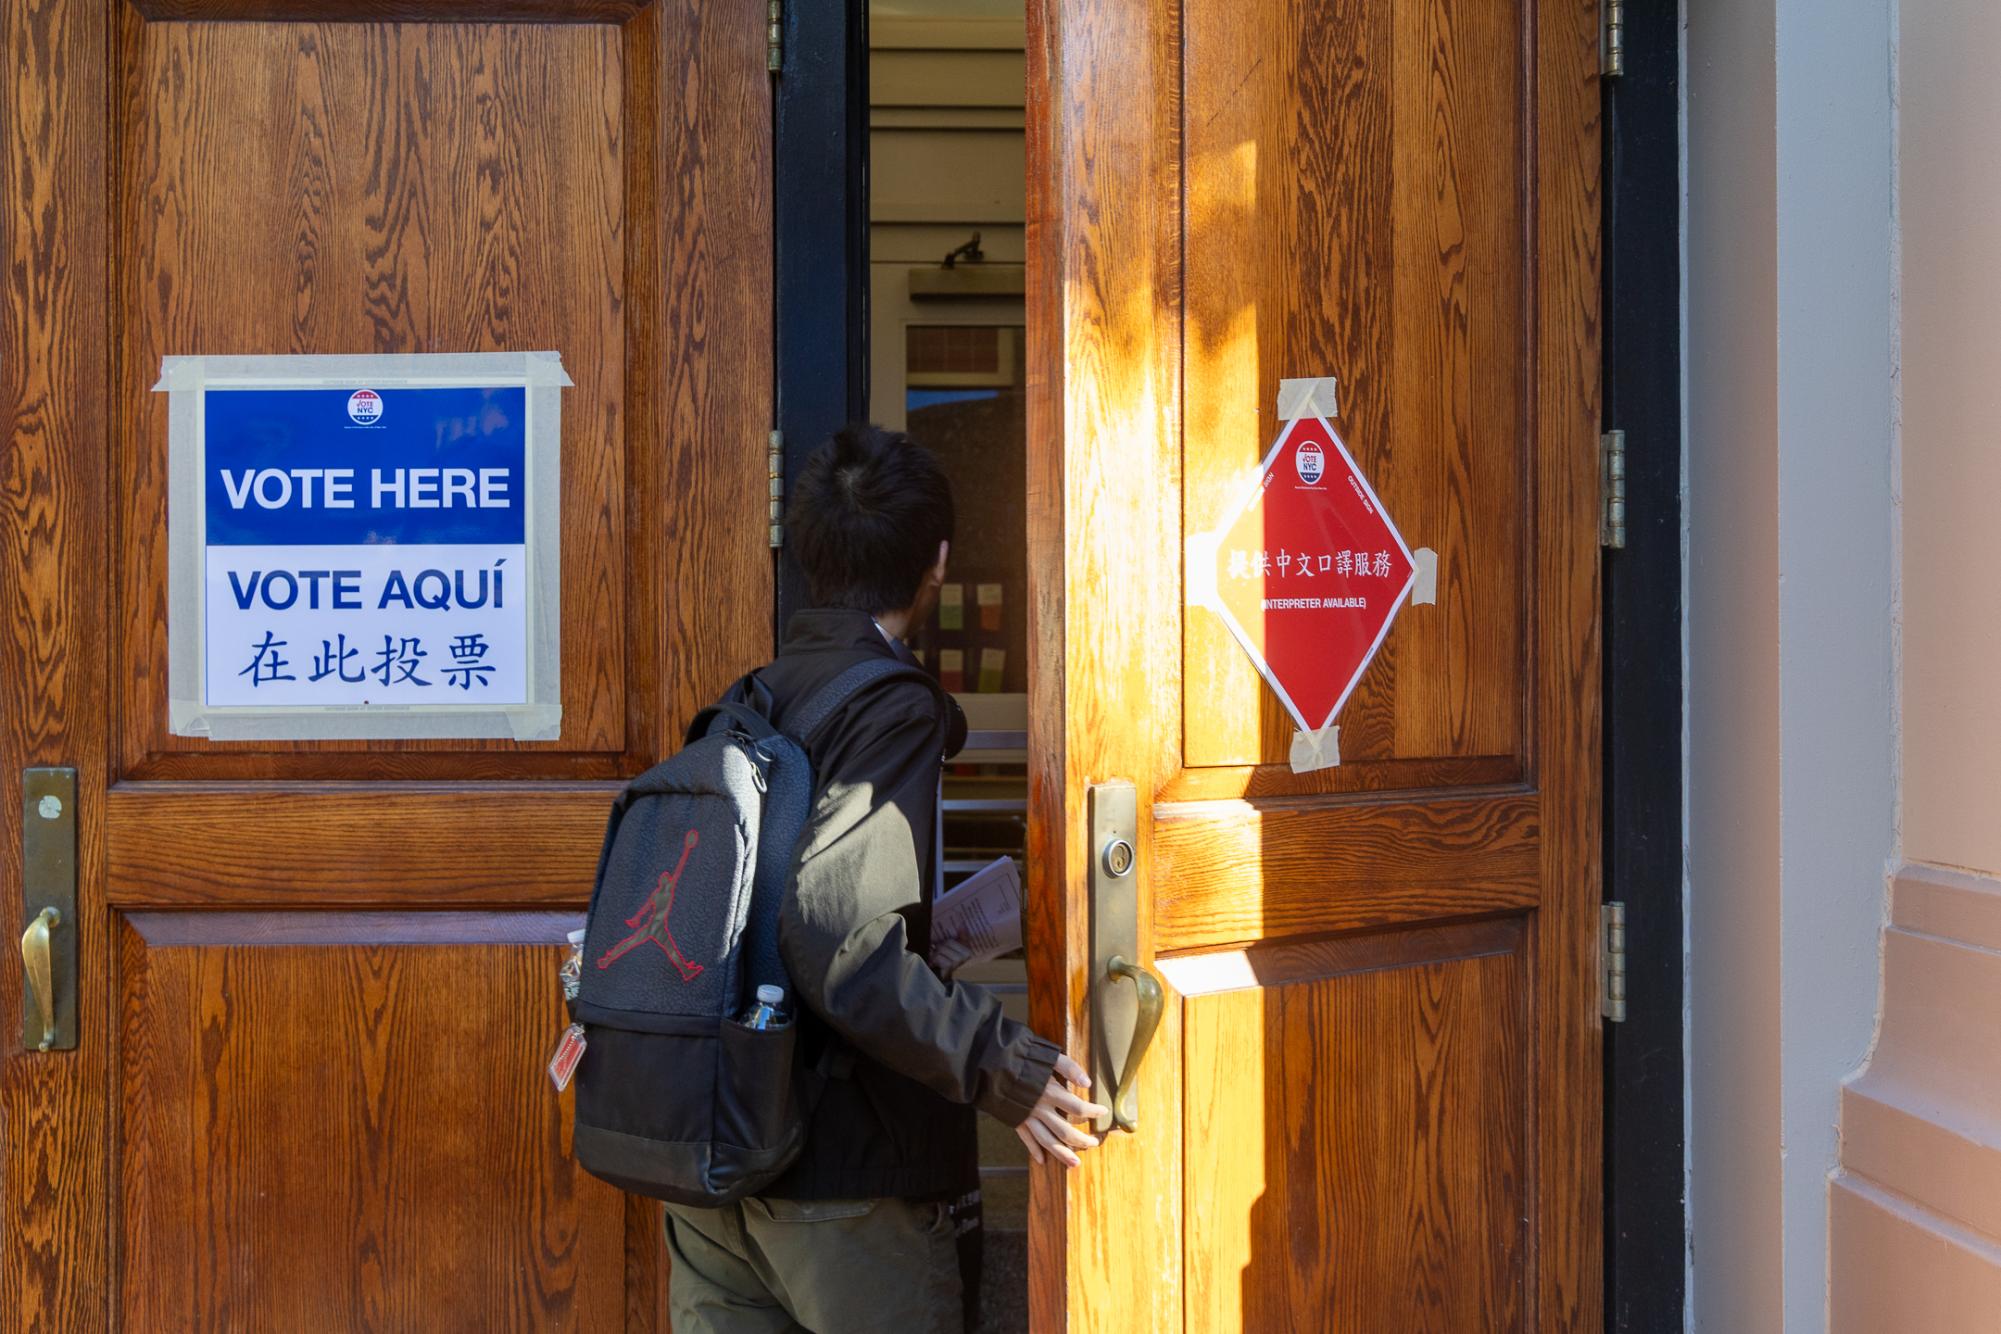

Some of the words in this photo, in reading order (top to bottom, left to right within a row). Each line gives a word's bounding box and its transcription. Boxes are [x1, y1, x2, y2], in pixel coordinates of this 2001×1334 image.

[1302, 463, 1318, 471] NYC
[220, 467, 355, 510] VOTE
[370, 467, 511, 509] HERE
[1228, 548, 1393, 579] 提供中文口譯服務
[227, 569, 362, 611] VOTE
[377, 557, 508, 612] AQUÍ
[1322, 596, 1367, 610] AVAILABLE)
[237, 630, 497, 691] 在此投票
